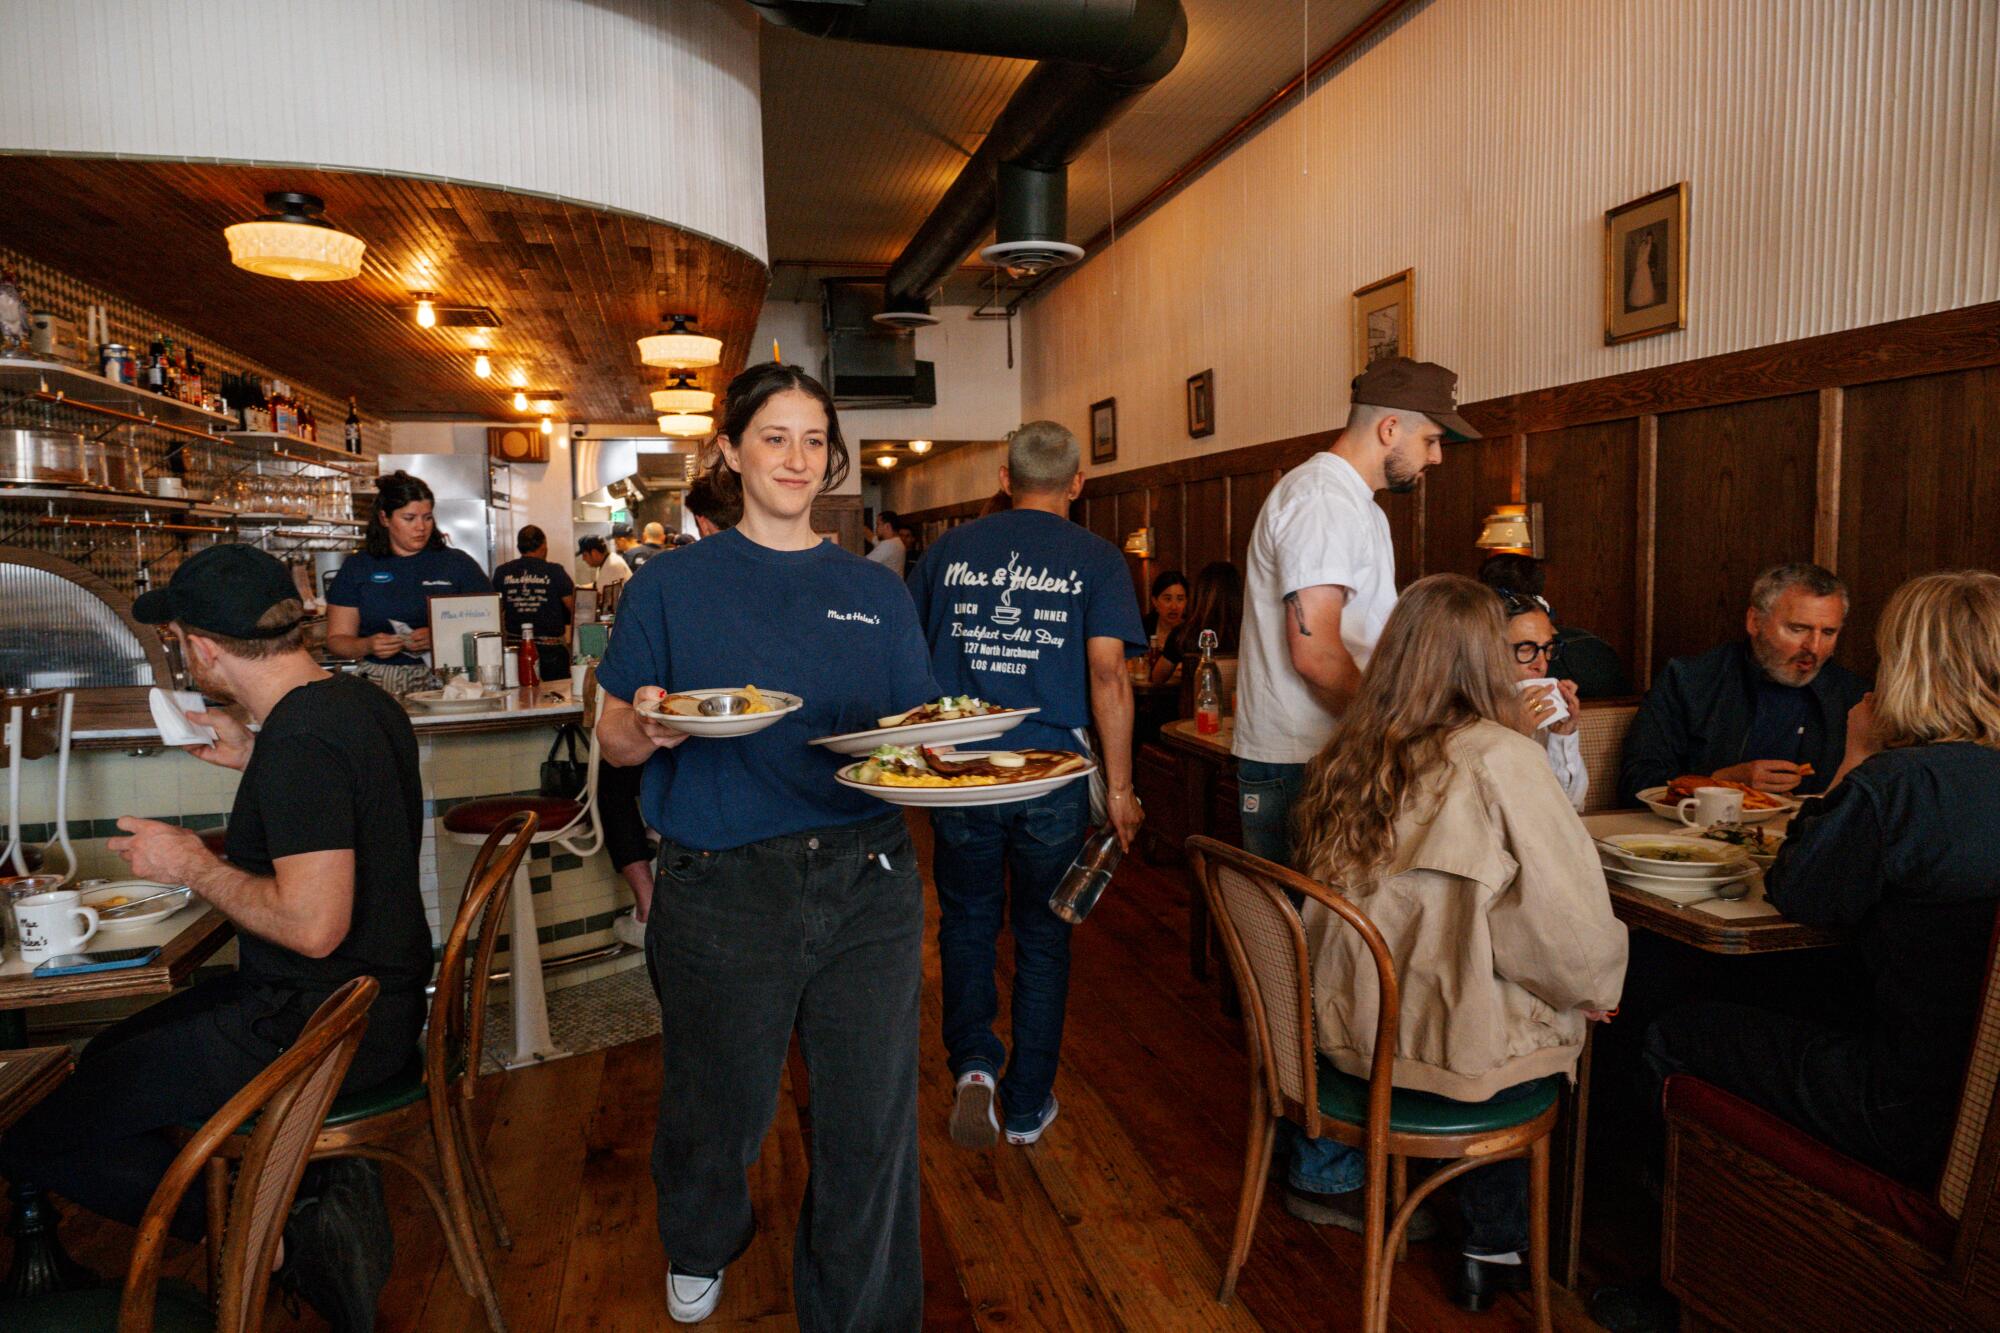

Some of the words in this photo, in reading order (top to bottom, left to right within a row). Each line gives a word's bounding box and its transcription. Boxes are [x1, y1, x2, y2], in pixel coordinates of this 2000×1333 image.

[944, 561, 989, 587] Max
[992, 567, 1007, 586] &
[1009, 566, 1083, 595] Helen's
[827, 609, 845, 621] Max
[852, 611, 880, 625] Helen's
[1034, 608, 1068, 623] DINNER
[1001, 626, 1032, 642] All
[1034, 628, 1065, 649] Day
[963, 642, 979, 654] 127
[979, 643, 1000, 657] North
[1001, 645, 1040, 660] Larchmont
[971, 659, 988, 671] LOS
[990, 661, 1028, 675] ANGELES
